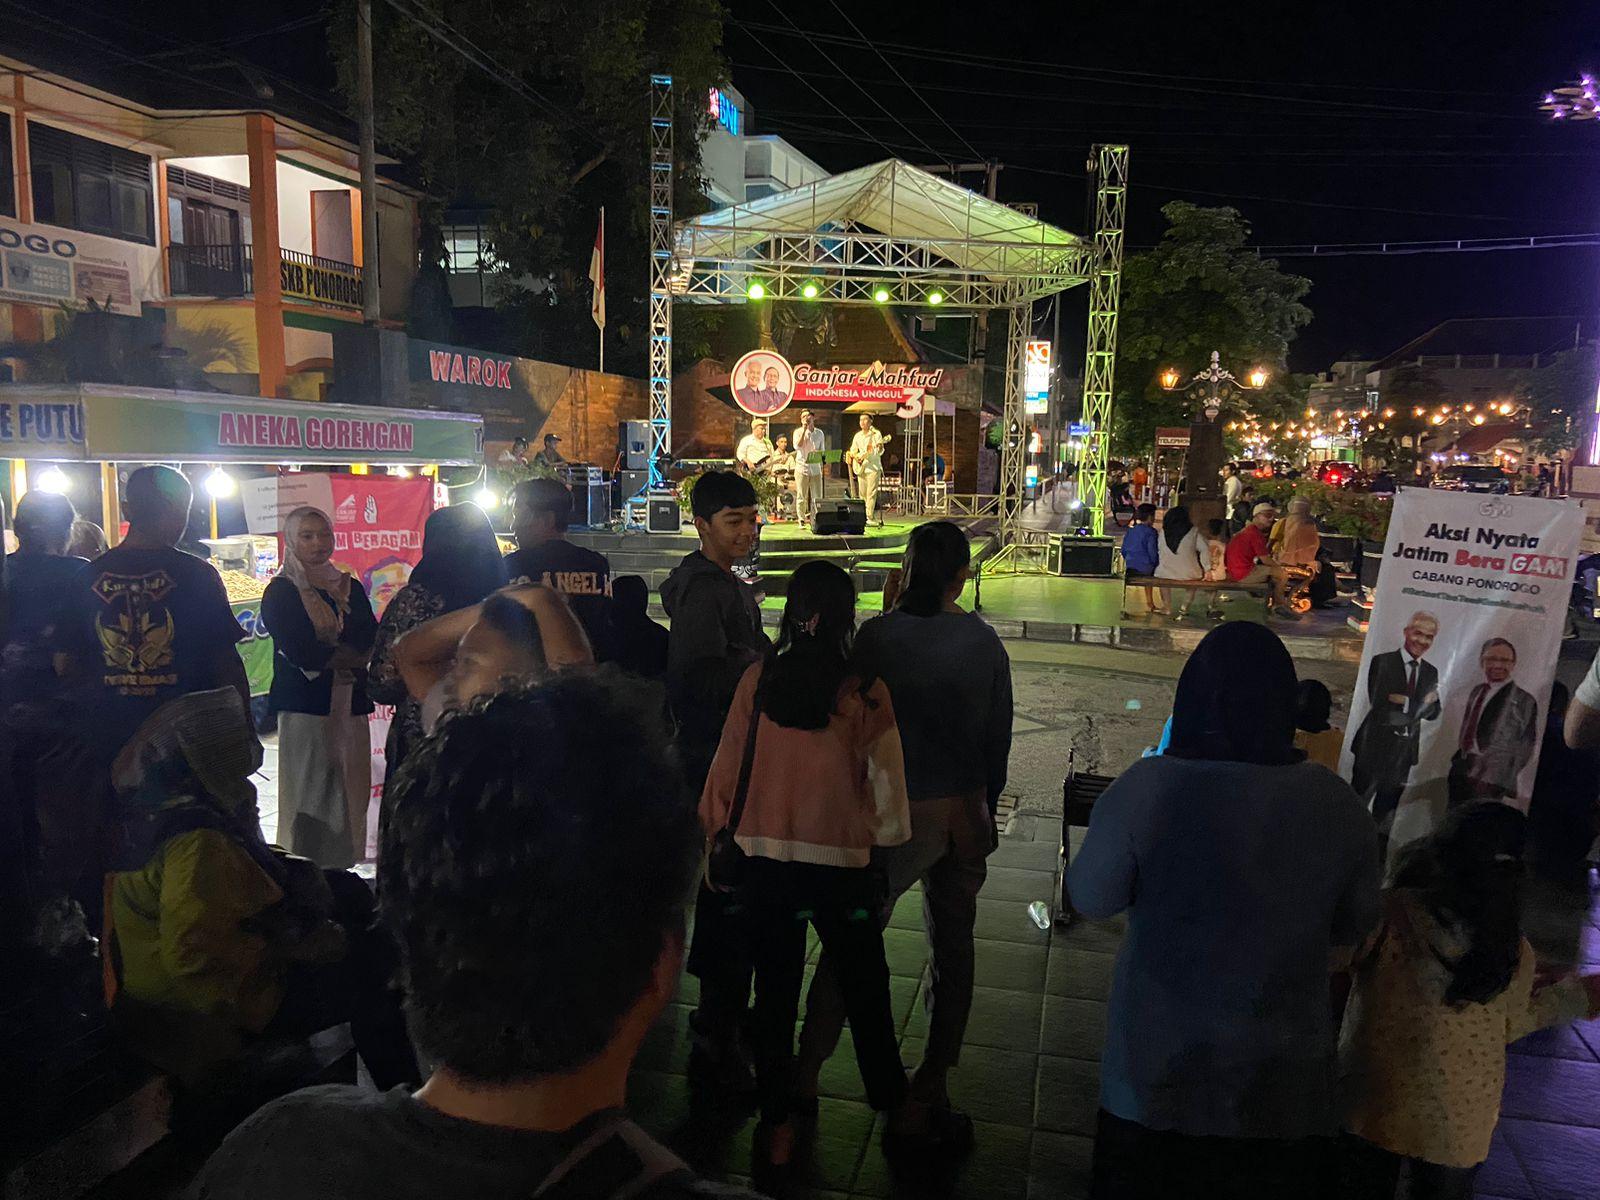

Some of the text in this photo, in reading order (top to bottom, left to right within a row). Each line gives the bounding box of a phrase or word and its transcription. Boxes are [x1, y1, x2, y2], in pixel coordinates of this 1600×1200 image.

[719, 92, 737, 137] BNI
[280, 261, 363, 306] SKB PONOROGO
[429, 351, 511, 388] WAROK
[805, 388, 903, 399] INDONESIA UNGGUL
[897, 388, 925, 419] 3
[19, 404, 84, 443] PUTU
[218, 412, 414, 451] ANEKA GORENGAN
[353, 531, 419, 551] BERAGAM
[1425, 523, 1540, 549] Aksi Nyata
[1392, 542, 1448, 564] Jatim
[1455, 549, 1505, 571] Bera
[1412, 570, 1541, 595] CABANG PONOROGO
